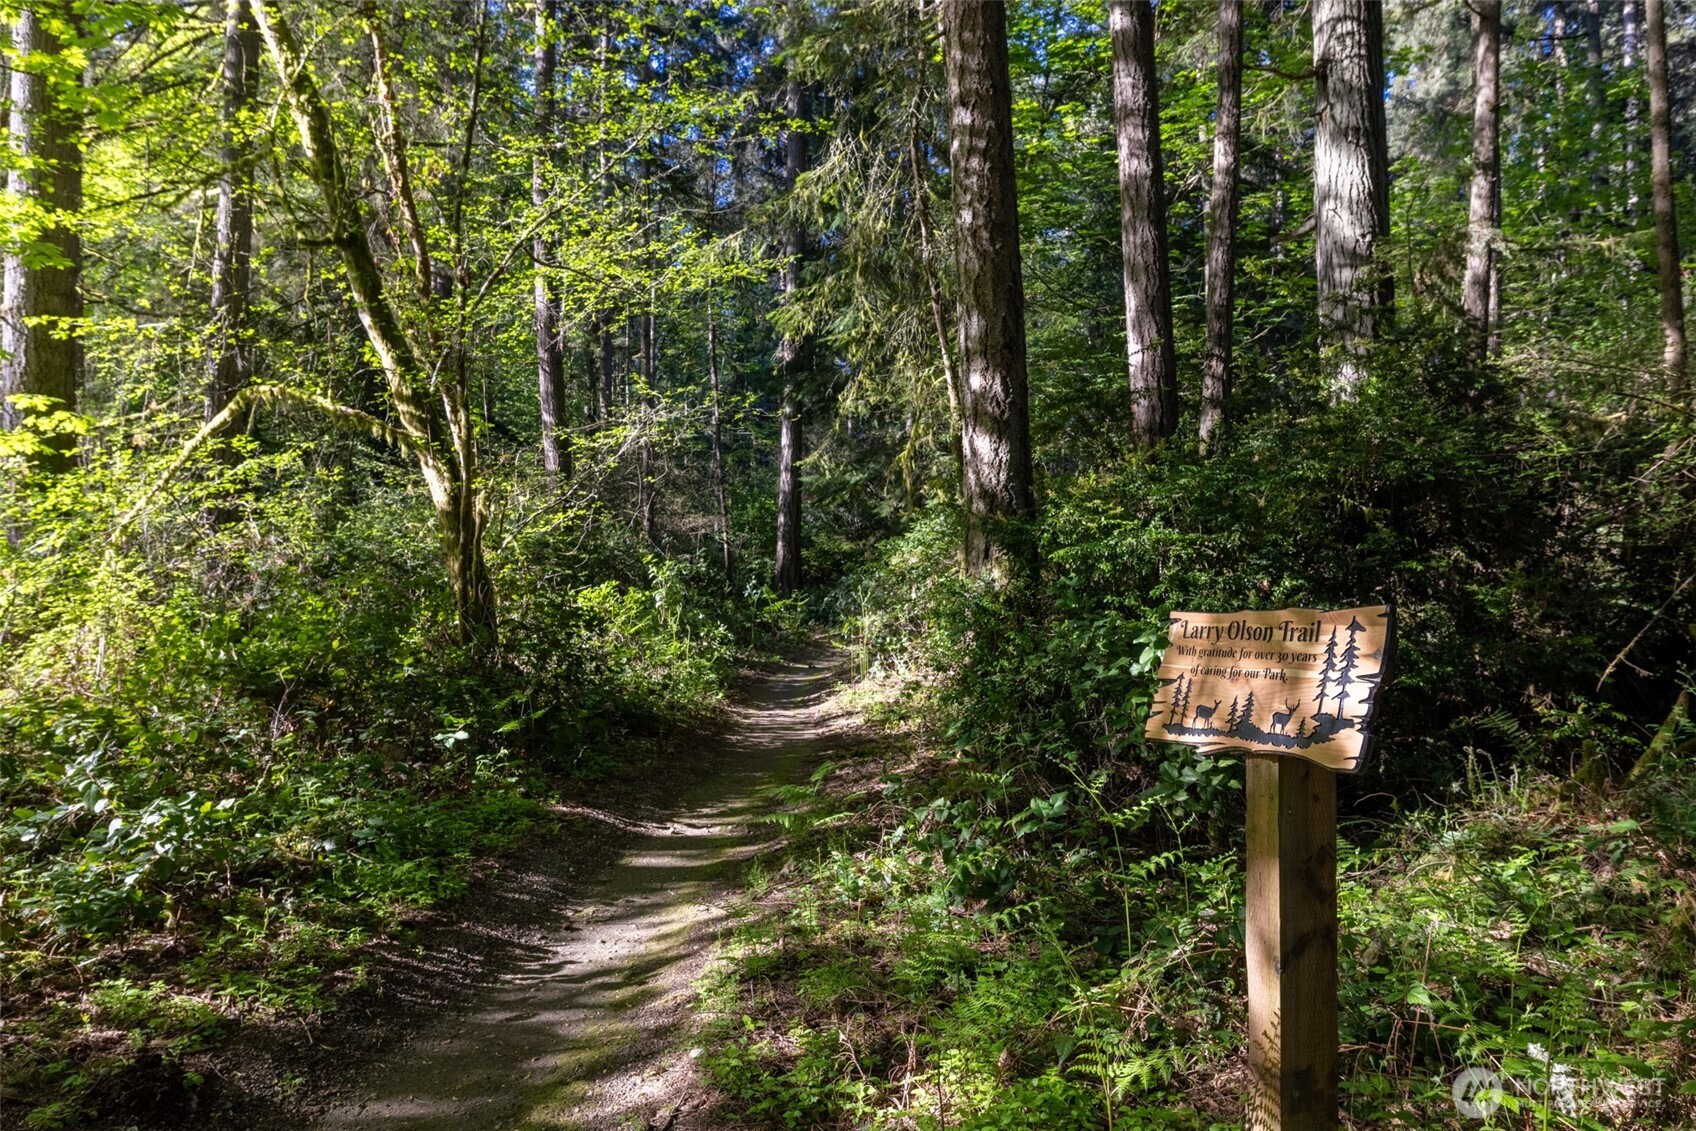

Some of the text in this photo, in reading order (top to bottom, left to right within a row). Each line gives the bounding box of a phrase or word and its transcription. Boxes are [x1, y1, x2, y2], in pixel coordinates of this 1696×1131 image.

[1180, 620, 1321, 645] Larry Olson Trail
[1177, 645, 1317, 664] With gratitude for over 30 years
[1190, 664, 1289, 684] of caring for our Park.
